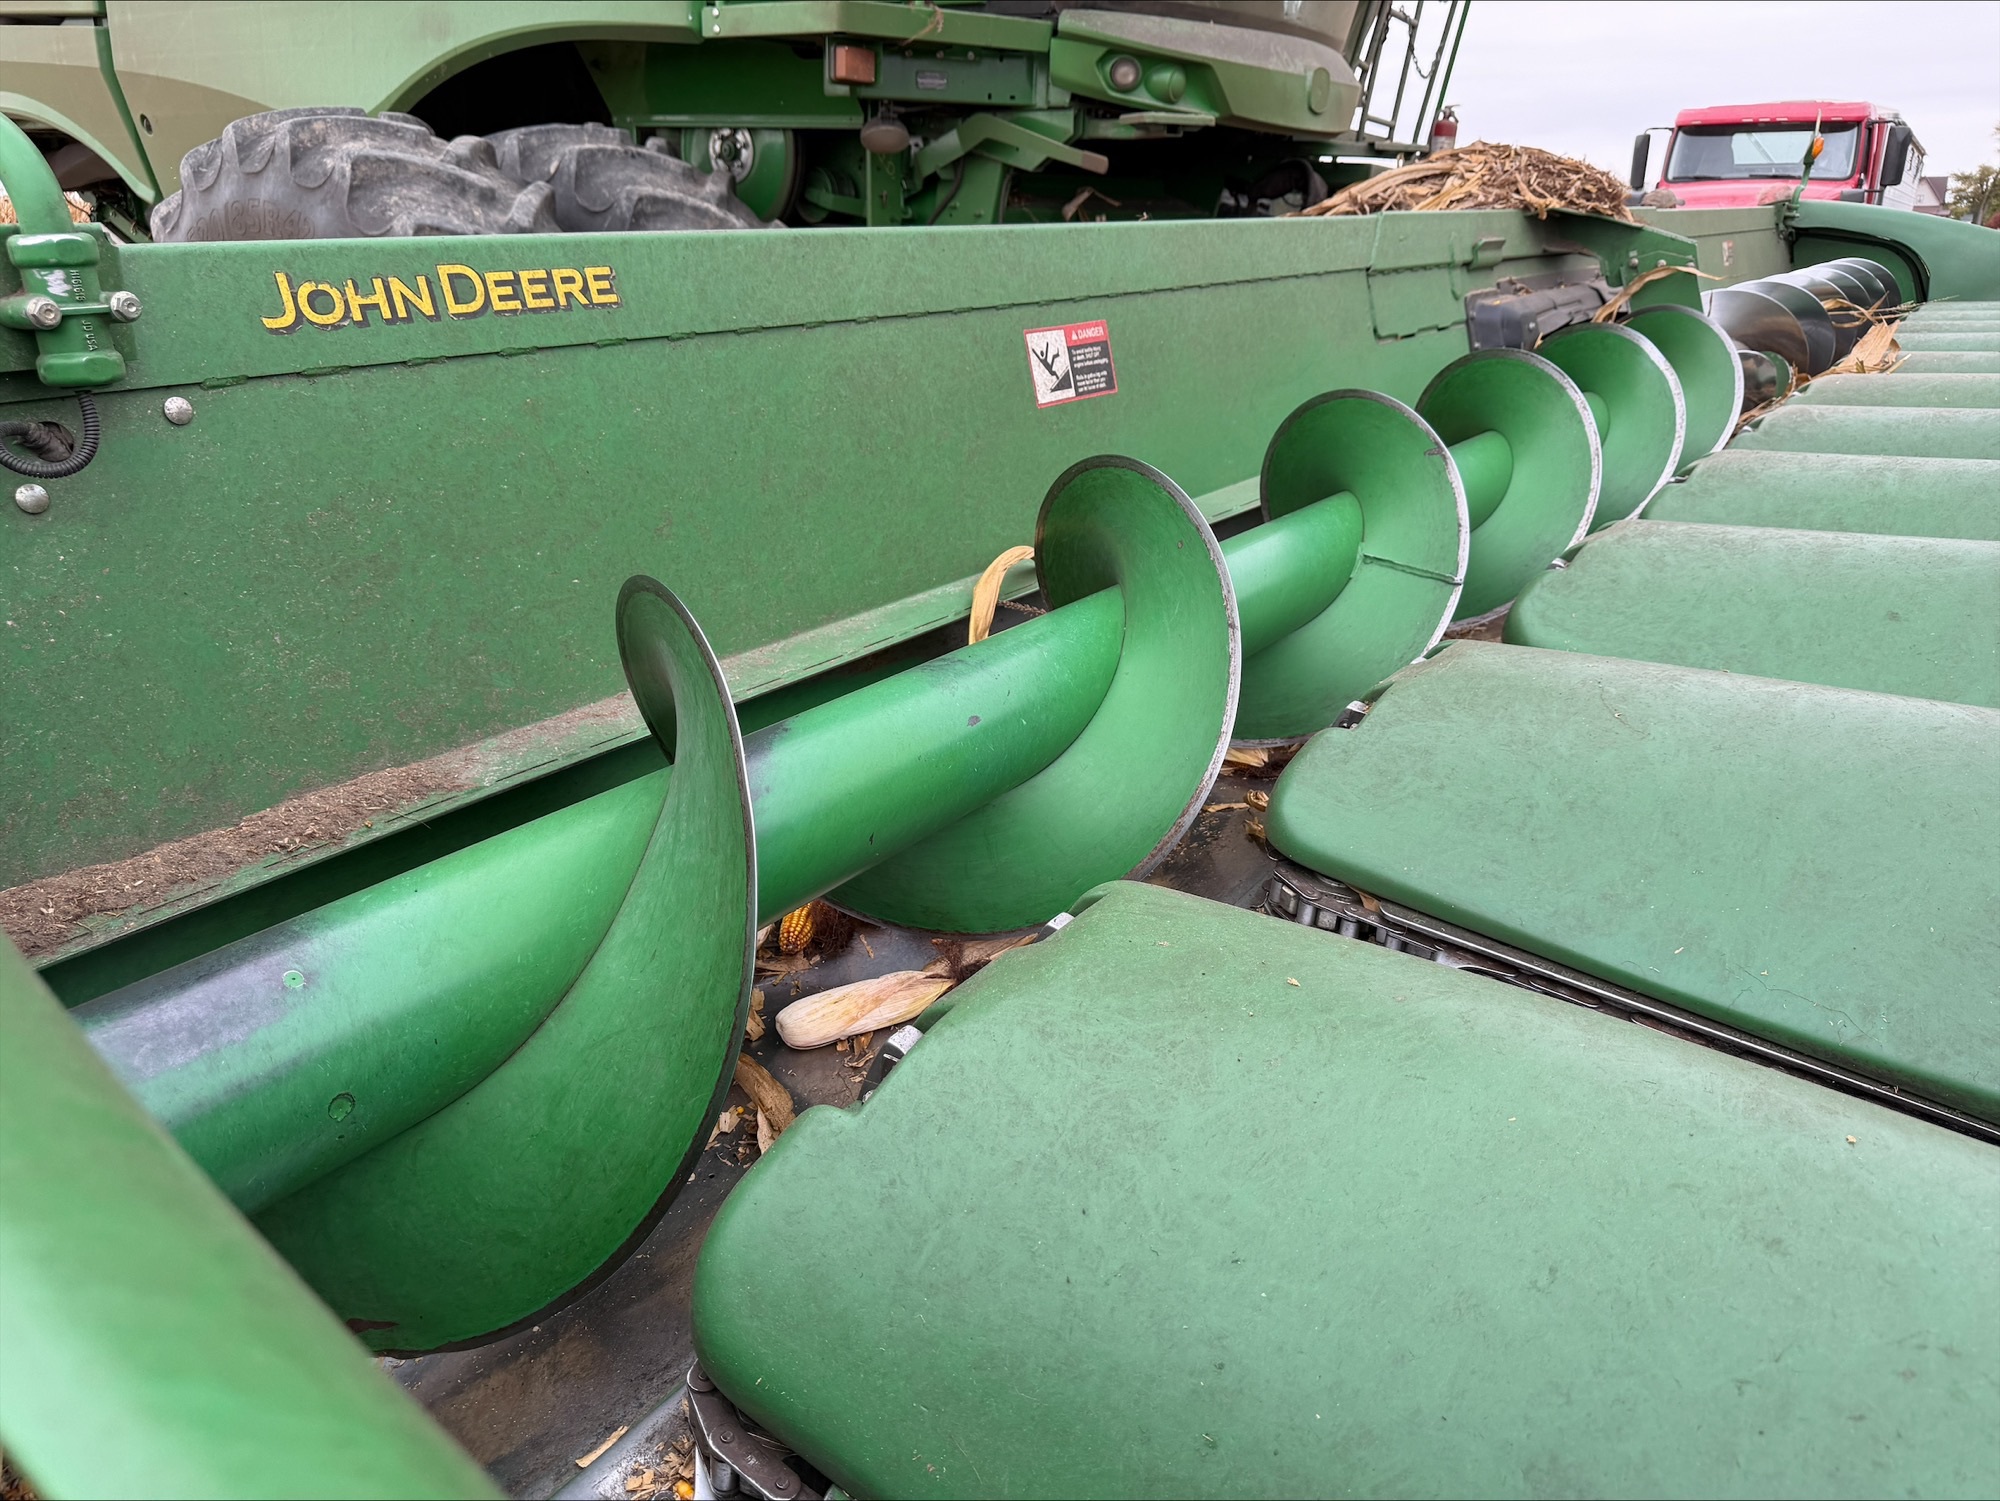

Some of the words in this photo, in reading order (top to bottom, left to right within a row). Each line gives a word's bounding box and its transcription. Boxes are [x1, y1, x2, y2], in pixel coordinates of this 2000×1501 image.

[260, 270, 440, 333] JOHN
[435, 263, 620, 319] DEERE
[85, 333, 99, 352] USA
[1077, 326, 1104, 340] DANGER
